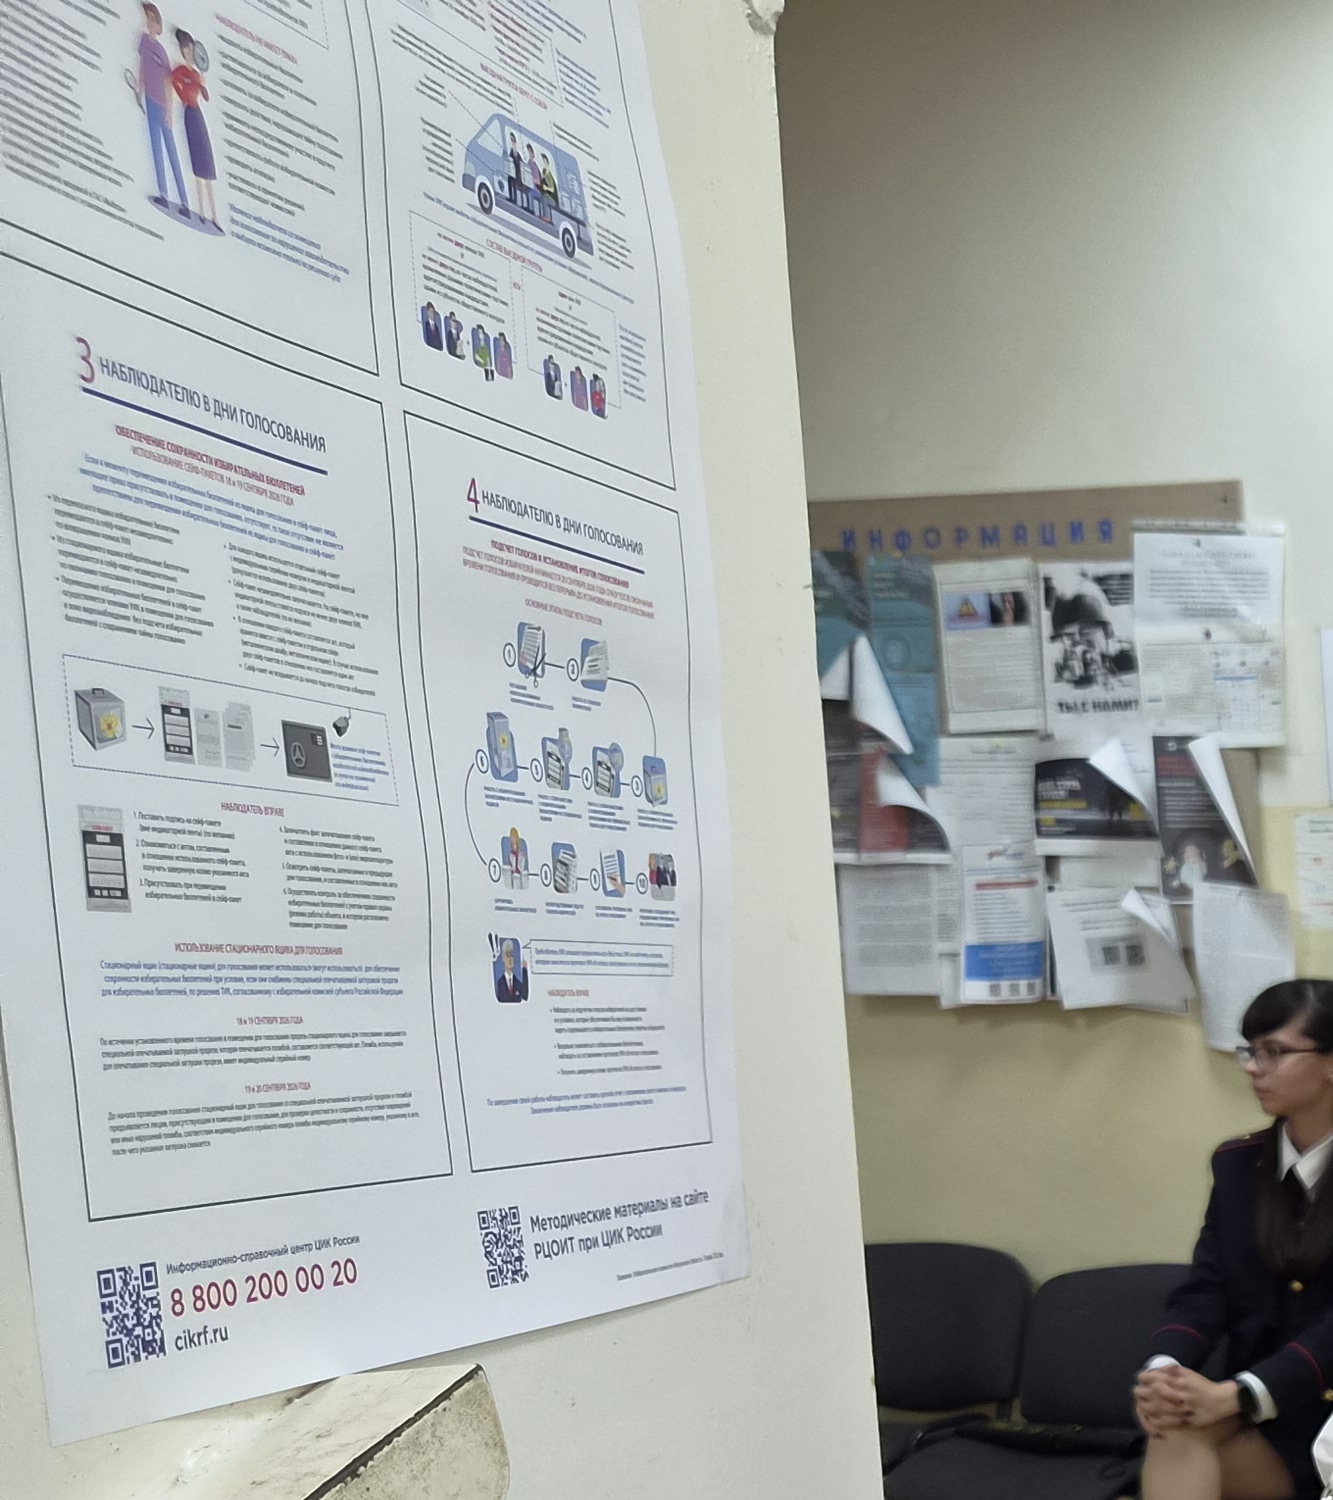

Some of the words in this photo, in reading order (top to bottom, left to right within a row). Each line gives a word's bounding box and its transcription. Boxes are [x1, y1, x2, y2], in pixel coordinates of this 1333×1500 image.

[76, 336, 95, 383] 3
[100, 356, 201, 409] НАБЛЮДАТЕЛЮ
[203, 394, 211, 412] В
[213, 398, 238, 420] ДНИ
[240, 409, 326, 453] ГОЛОСОВАНИЯ
[467, 477, 480, 513] 4
[482, 490, 554, 528] НАБЛЮДАТЕЛЮ
[555, 514, 562, 529] В
[563, 517, 582, 534] ДНИ
[583, 523, 644, 556] ГОЛОСОВАНИЯ
[841, 518, 1114, 551] ИНФОРМАЦИЯ
[530, 1207, 612, 1233] Методические
[613, 1197, 669, 1219] материалы
[670, 1194, 683, 1208] на
[684, 1189, 709, 1207] сайте
[166, 1245, 289, 1275] Информационно-справочный
[290, 1242, 313, 1255] центр
[314, 1238, 332, 1251] ЦИК
[333, 1235, 360, 1248] России
[534, 1236, 575, 1260] РЦОИТ
[578, 1235, 600, 1253] при
[601, 1227, 625, 1249] ЦИК
[627, 1224, 663, 1242] России
[170, 1288, 185, 1317] 8
[192, 1278, 237, 1313] 800
[244, 1270, 288, 1303] 200
[295, 1263, 325, 1293] 00
[330, 1257, 358, 1287] 20
[174, 1325, 229, 1351] cikrf.ru
